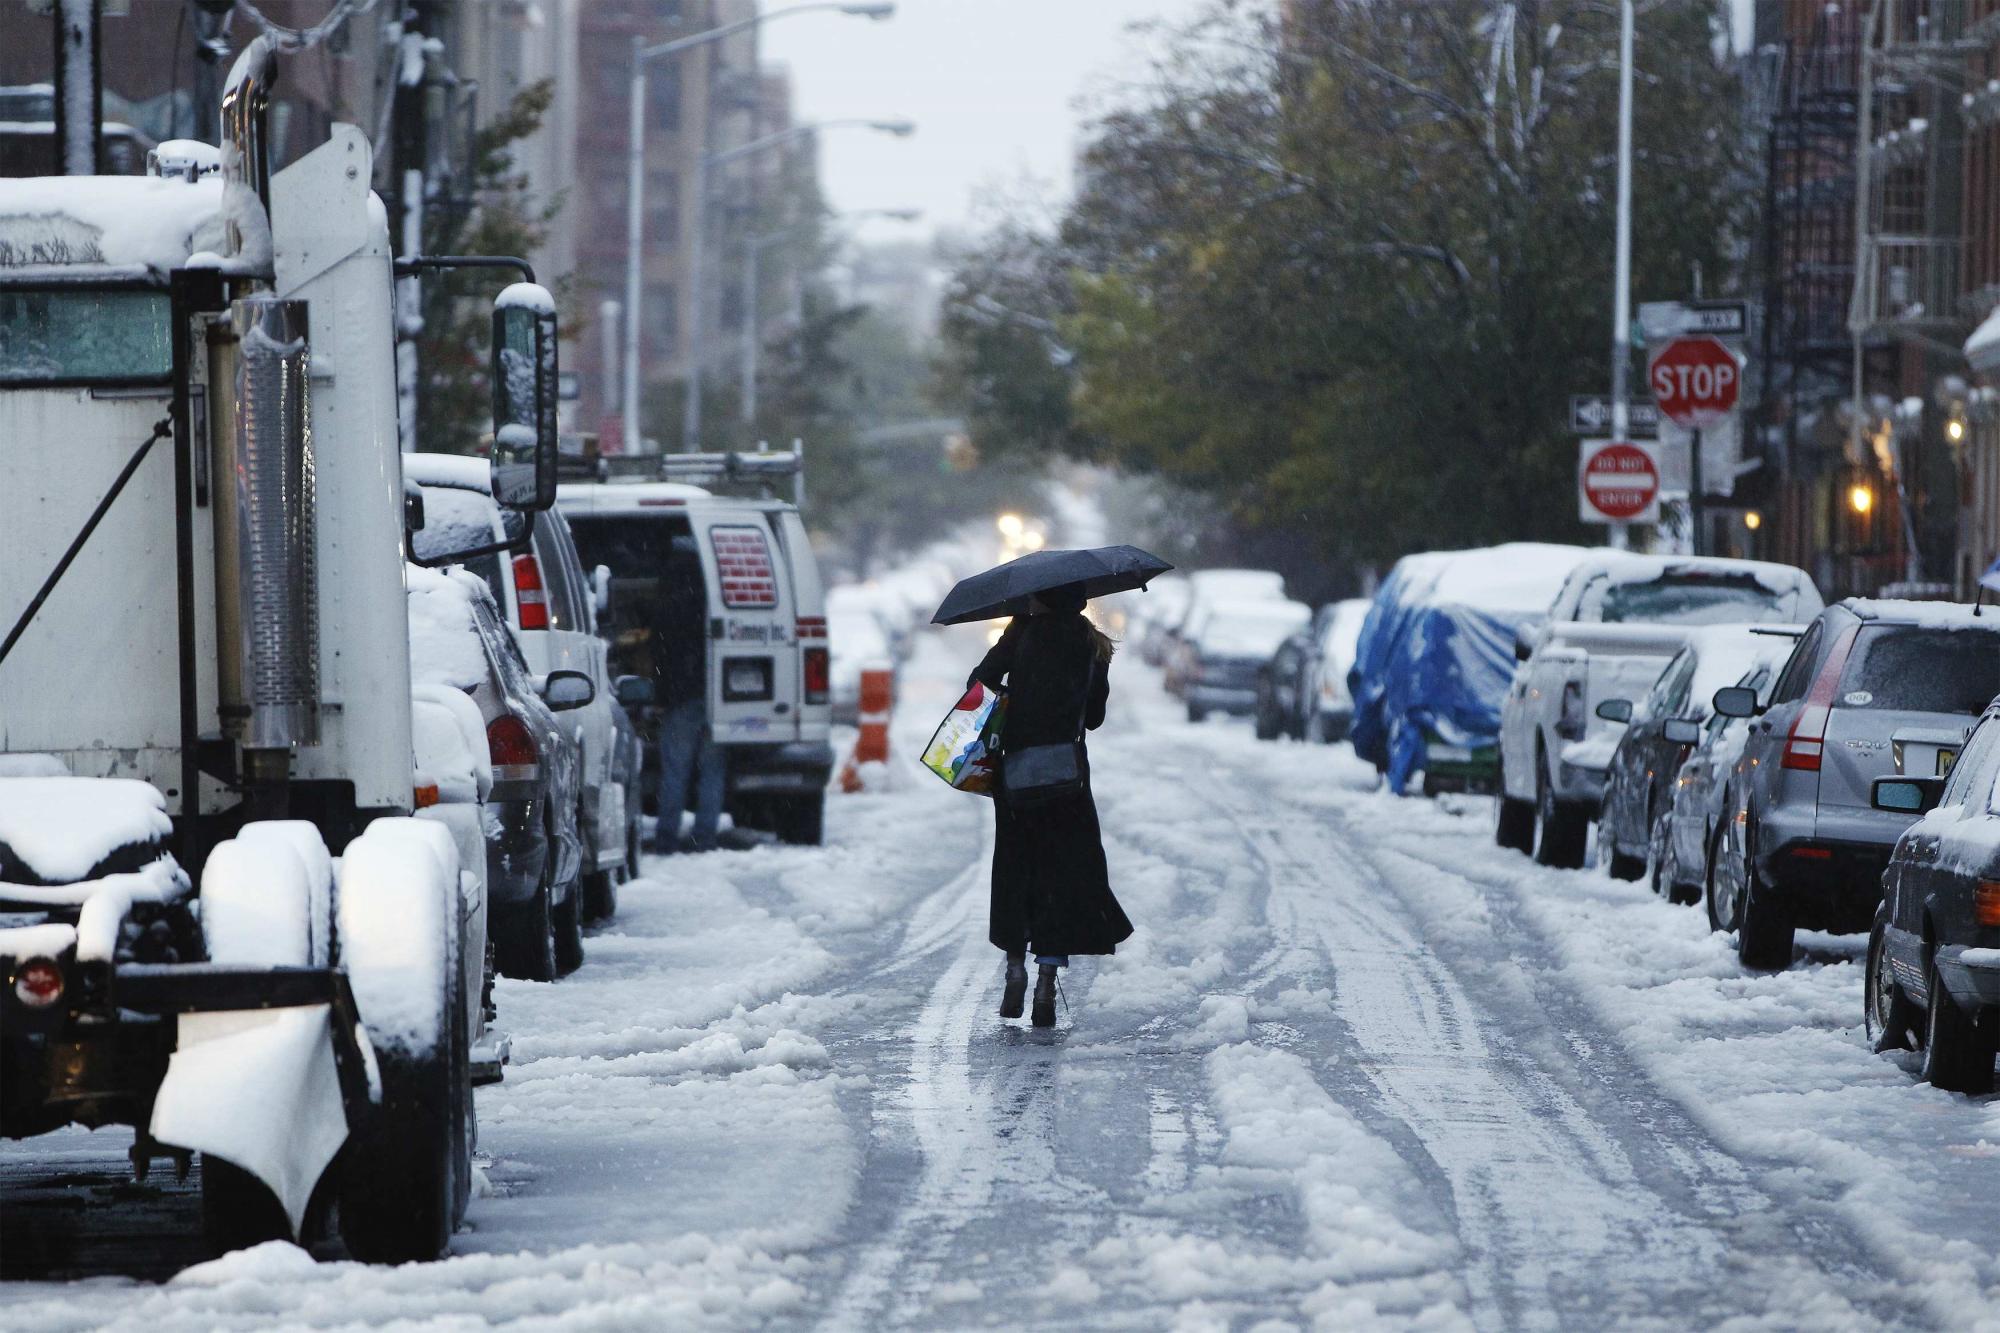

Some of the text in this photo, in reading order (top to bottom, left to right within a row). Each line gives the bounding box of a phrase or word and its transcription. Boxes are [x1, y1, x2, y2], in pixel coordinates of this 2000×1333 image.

[1701, 310, 1734, 328] WAY
[1655, 365, 1734, 400] STOP
[1621, 456, 1645, 470] NOT
